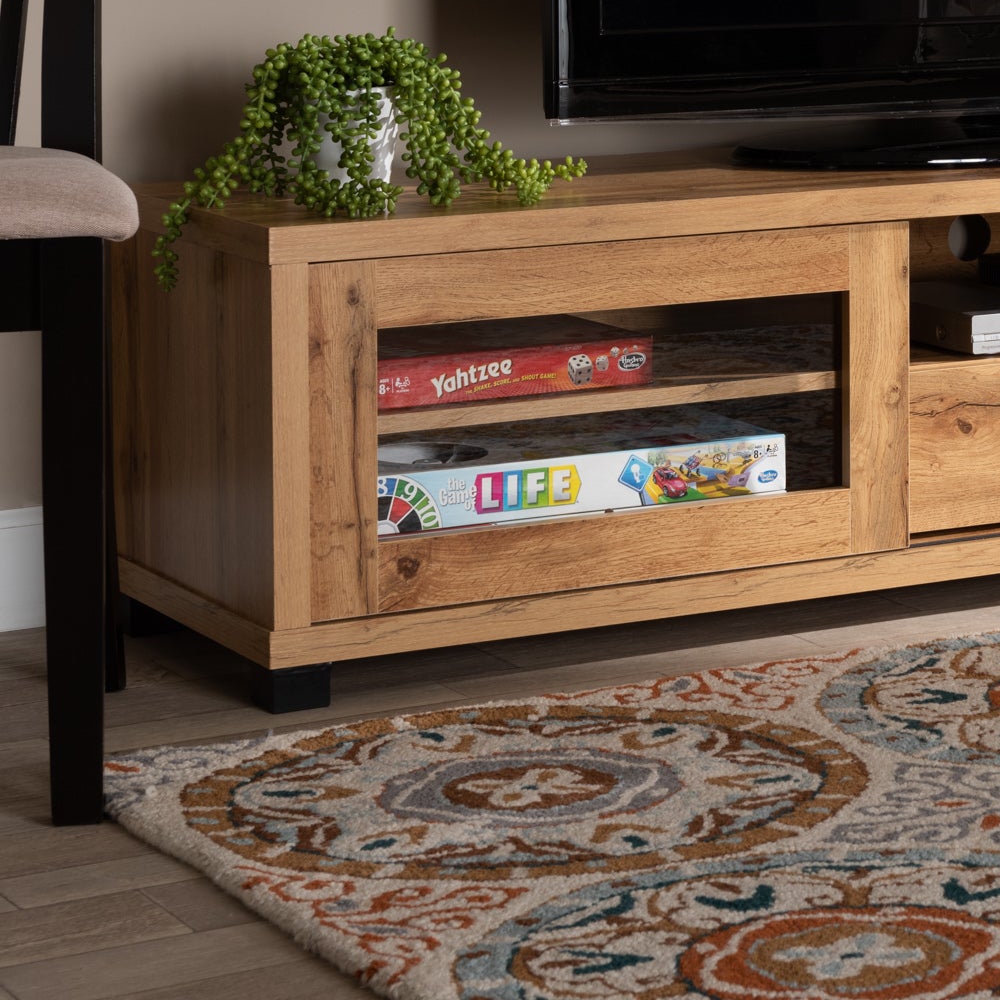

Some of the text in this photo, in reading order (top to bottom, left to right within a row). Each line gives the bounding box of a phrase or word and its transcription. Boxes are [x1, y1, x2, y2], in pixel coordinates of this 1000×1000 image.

[430, 359, 513, 398] Yahtzee
[521, 373, 539, 382] SHOUT
[379, 384, 391, 395] 8+
[448, 477, 465, 491] the
[481, 470, 571, 509] LIFE
[400, 483, 418, 502] 9
[438, 485, 477, 506] Game
[464, 498, 475, 511] of
